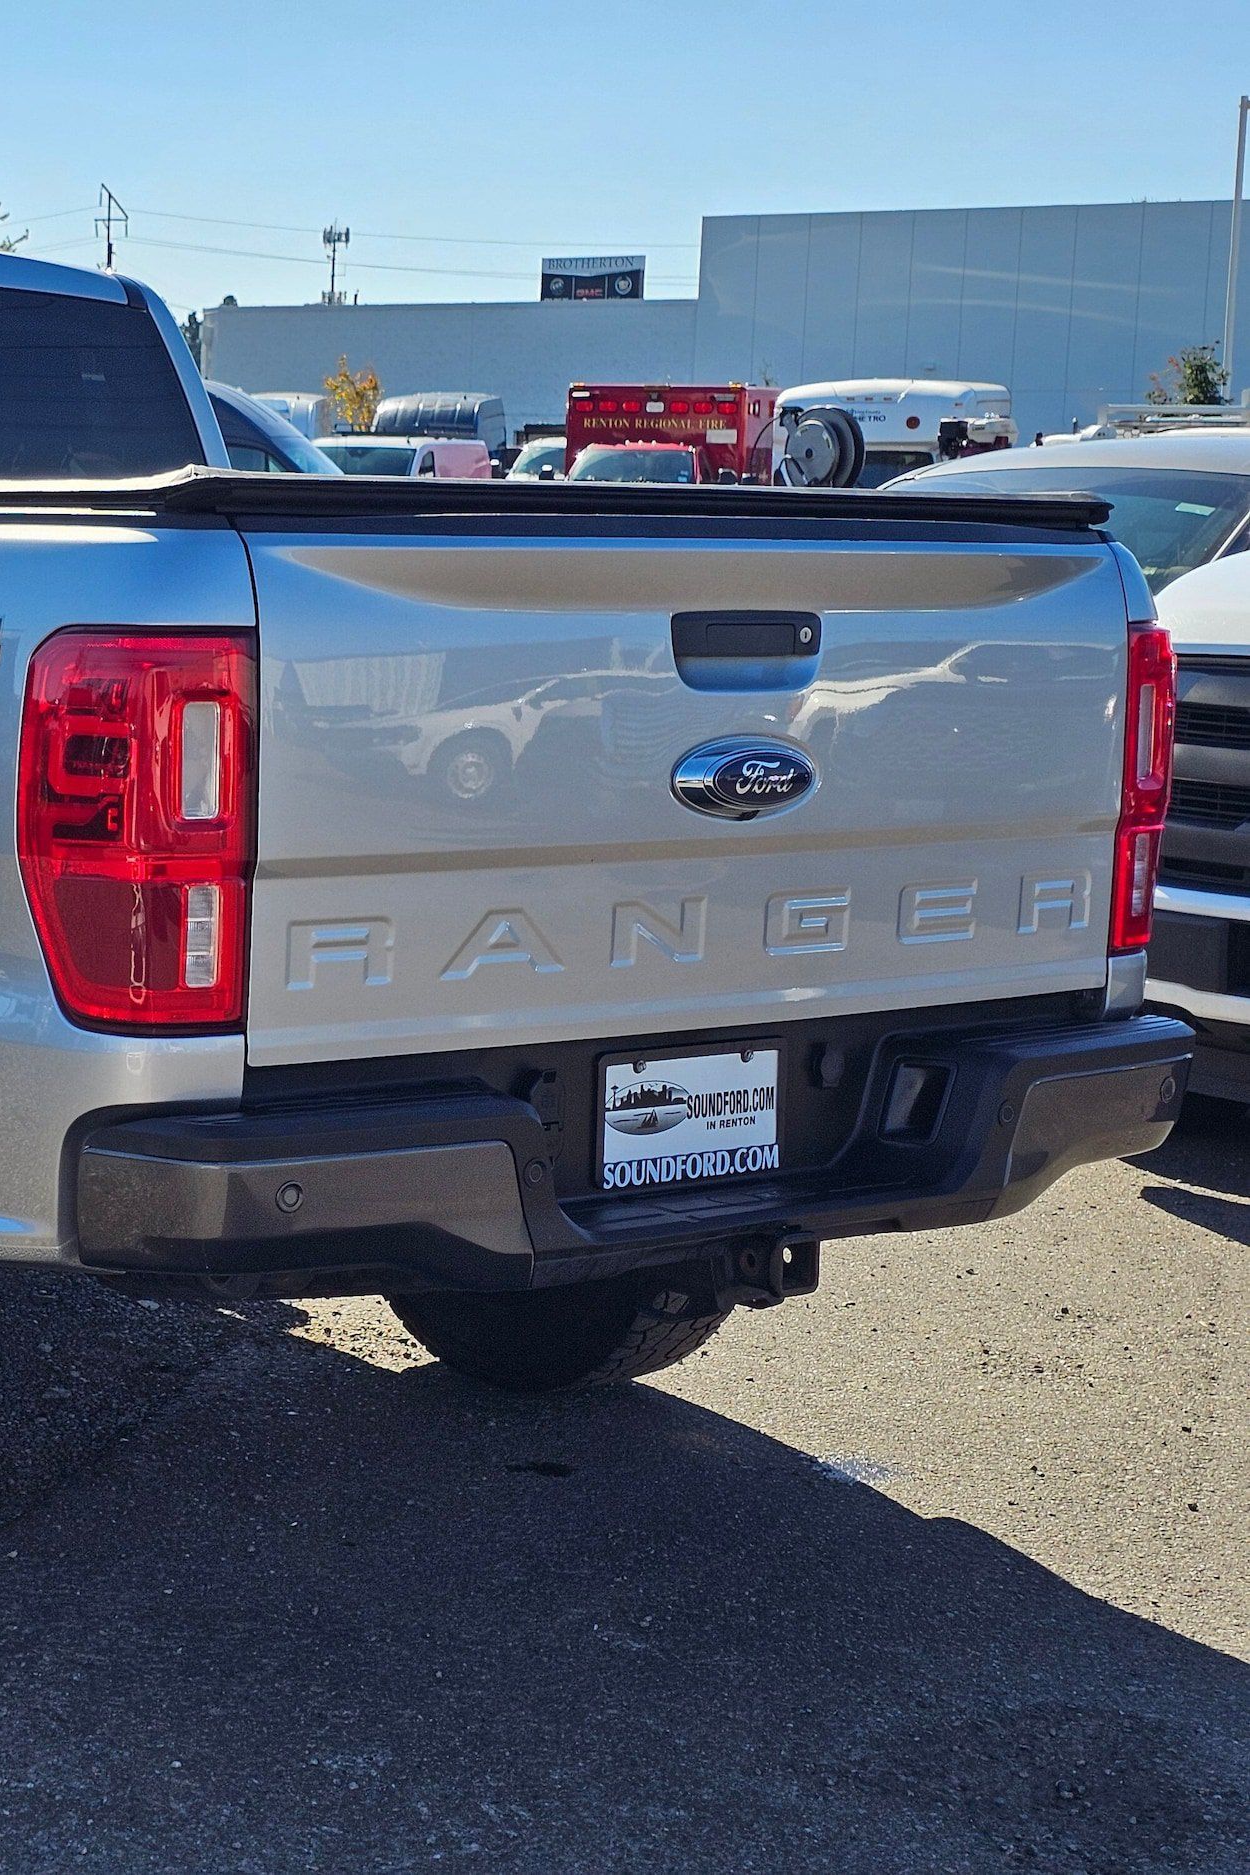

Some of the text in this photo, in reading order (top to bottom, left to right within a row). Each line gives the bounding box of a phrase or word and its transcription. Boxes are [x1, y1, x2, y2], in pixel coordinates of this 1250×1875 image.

[548, 257, 635, 270] BROTHERTON
[583, 418, 726, 430] RENTON REGIONAL FIRE
[736, 760, 796, 795] Ford
[284, 870, 1091, 992] RANGER
[686, 1086, 775, 1119] SOUNDFORD.COM
[706, 1116, 756, 1130] IN RENTON
[603, 1144, 780, 1190] SOUNDFORD.COM
